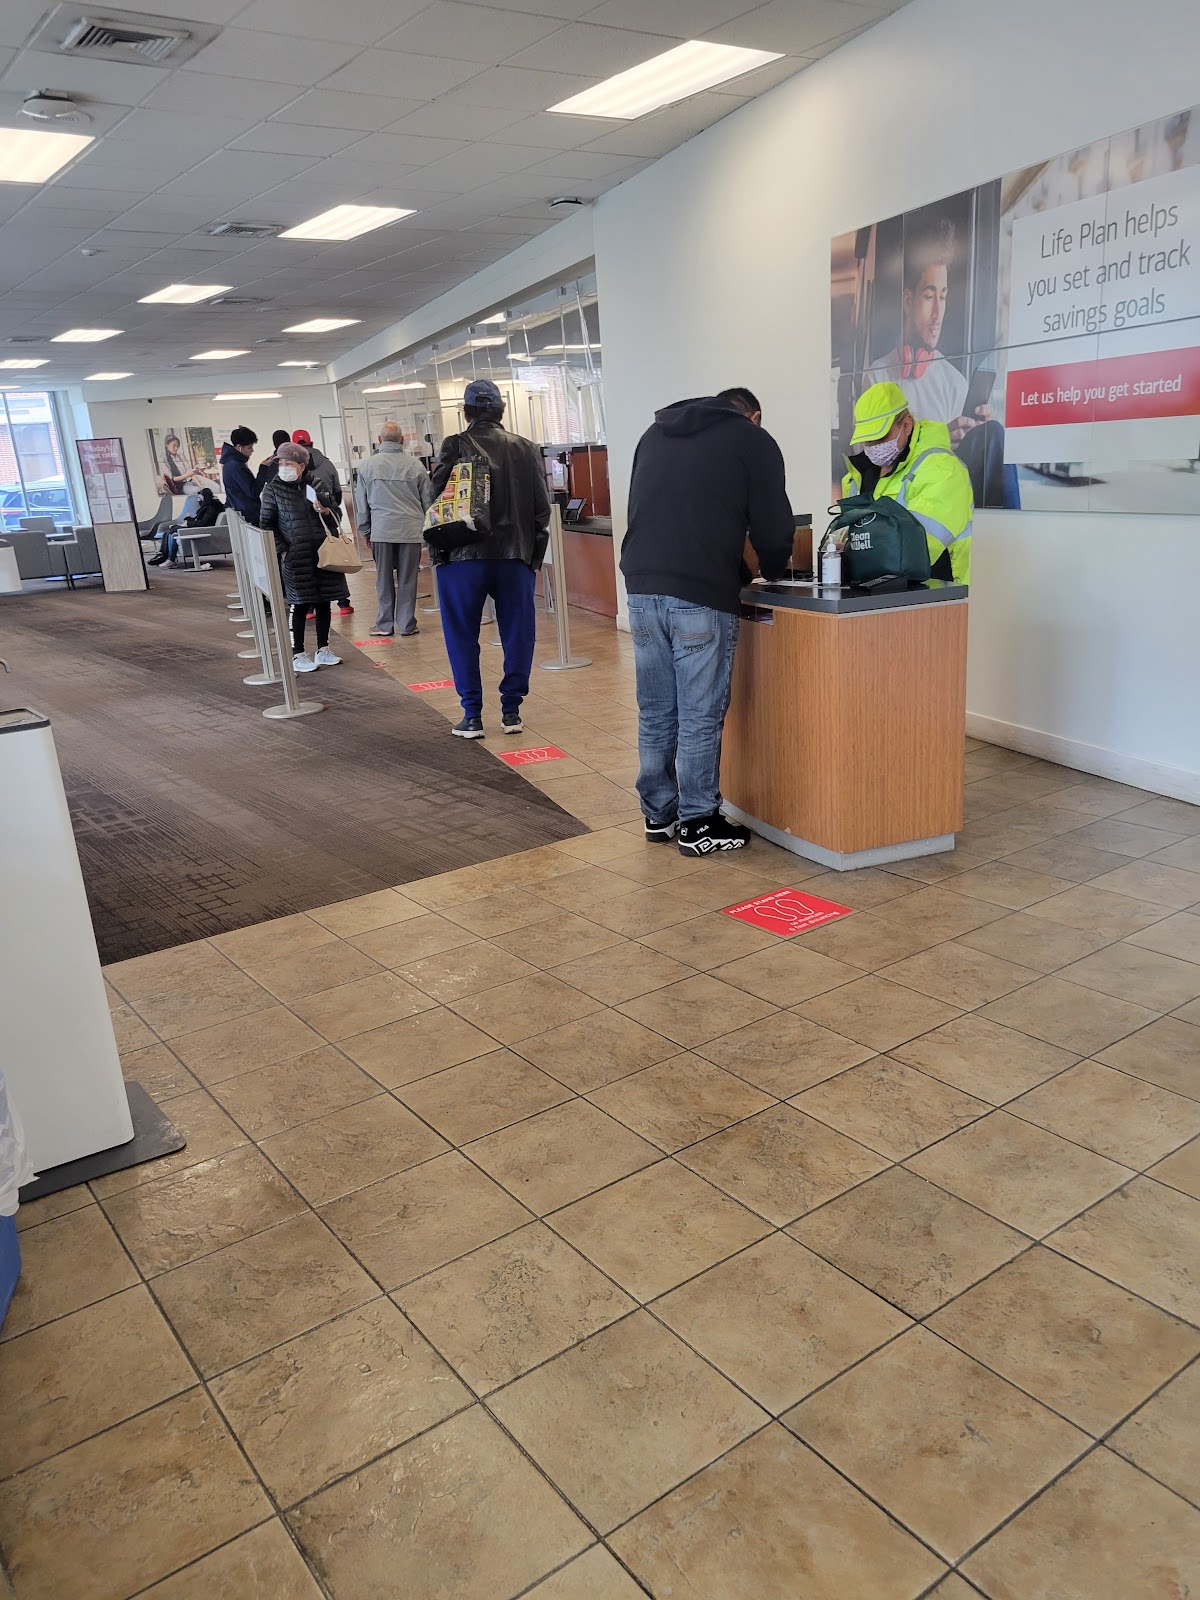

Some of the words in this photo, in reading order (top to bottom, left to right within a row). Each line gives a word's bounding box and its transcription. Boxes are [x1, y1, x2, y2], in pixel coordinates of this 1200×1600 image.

[1041, 228, 1073, 259] Life
[1079, 220, 1118, 249] Plan
[1125, 203, 1179, 238] helps
[1027, 276, 1057, 306] you
[1062, 265, 1091, 292] set
[1096, 251, 1132, 285] and
[1138, 238, 1192, 276] track
[1042, 304, 1108, 334] savings
[1113, 287, 1166, 328] goals
[1020, 391, 1039, 406] Let
[1041, 391, 1055, 404] us
[1056, 385, 1081, 406] help
[1083, 386, 1105, 405] you
[1108, 381, 1130, 402] get
[1132, 374, 1182, 396] started
[729, 902, 754, 914] PLEASE
[753, 895, 775, 906] STAND
[774, 890, 792, 898] HERE
